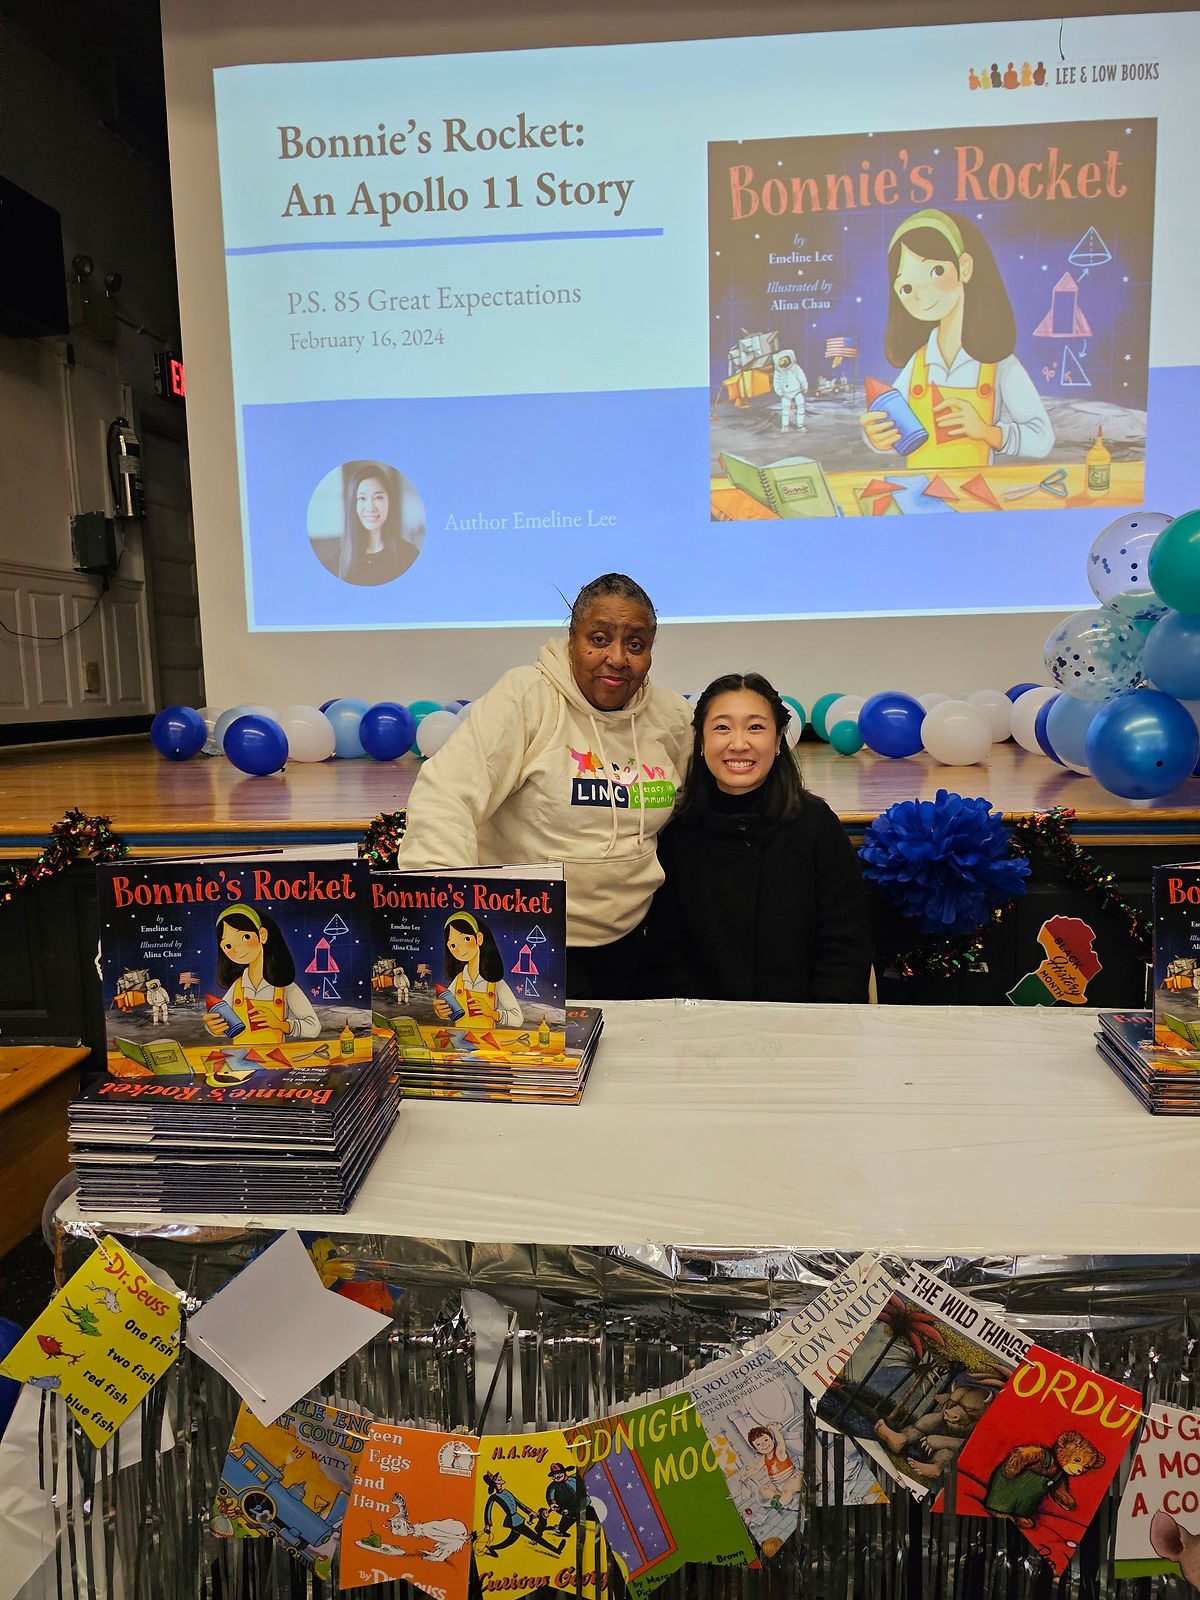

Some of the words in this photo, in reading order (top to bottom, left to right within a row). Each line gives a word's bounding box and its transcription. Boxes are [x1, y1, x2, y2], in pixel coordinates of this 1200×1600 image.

[1056, 67, 1076, 85] LEE
[1080, 66, 1087, 83] &
[1092, 64, 1117, 83] LOW
[1121, 63, 1160, 81] BOOKS
[278, 119, 432, 160] Bonnie's
[443, 112, 585, 153] Rocket:
[729, 149, 935, 221] Bonnie's
[954, 145, 1128, 202] Rocket
[281, 182, 336, 217] An
[347, 175, 469, 228] Apollo
[482, 175, 523, 209] 11
[536, 172, 635, 217] Story
[793, 233, 806, 248] by
[768, 251, 812, 264] Emeline
[815, 251, 834, 262] Lee
[288, 291, 326, 315] P.S.
[334, 291, 360, 312] 85
[368, 289, 431, 311] Great
[437, 284, 582, 317] Expectations
[766, 280, 819, 293] Illustrated
[821, 280, 833, 295] by
[770, 299, 799, 311] Alina
[801, 298, 831, 310] Chau
[290, 331, 365, 353] February
[371, 330, 397, 349] 16,
[402, 328, 445, 346] 2024
[444, 513, 508, 531] Author
[513, 510, 582, 529] Emeline
[587, 509, 617, 528] Lee
[577, 784, 626, 803] LINC
[112, 870, 243, 908] Bonnie's
[253, 870, 356, 900] Rocket
[371, 883, 465, 909] Bonnie's
[473, 884, 553, 914] Rocket
[1054, 937, 1082, 970] BLACK
[1040, 970, 1065, 998] MONTH
[1047, 956, 1081, 996] History
[98, 1083, 202, 1101] Rocket
[104, 1252, 130, 1285] Dr.
[127, 1275, 170, 1316] Seuss
[791, 1272, 858, 1336] GUESS
[911, 1272, 944, 1305] THE
[938, 1292, 979, 1329] WILD
[124, 1319, 149, 1341] One
[148, 1335, 174, 1357] fish
[782, 1325, 836, 1378] HOW
[107, 1347, 130, 1369] two
[131, 1363, 157, 1386] fish
[82, 1370, 106, 1388] red
[103, 1383, 129, 1406] fish
[702, 1373, 731, 1394] YOU
[65, 1393, 90, 1416] blue
[90, 1411, 115, 1433] fish
[298, 1421, 365, 1454] COULD
[291, 1446, 307, 1460] by
[310, 1451, 350, 1471] WATTY
[369, 1448, 412, 1474] Eggs
[492, 1446, 506, 1460] H.
[507, 1445, 520, 1460] A.
[1130, 1455, 1147, 1481] A
[354, 1475, 385, 1491] and
[353, 1493, 391, 1513] Ham
[1132, 1493, 1149, 1518] A
[1163, 1490, 1199, 1515] CO
[716, 1550, 744, 1563] Brown
[359, 1571, 372, 1581] By
[479, 1570, 550, 1592] Curious
